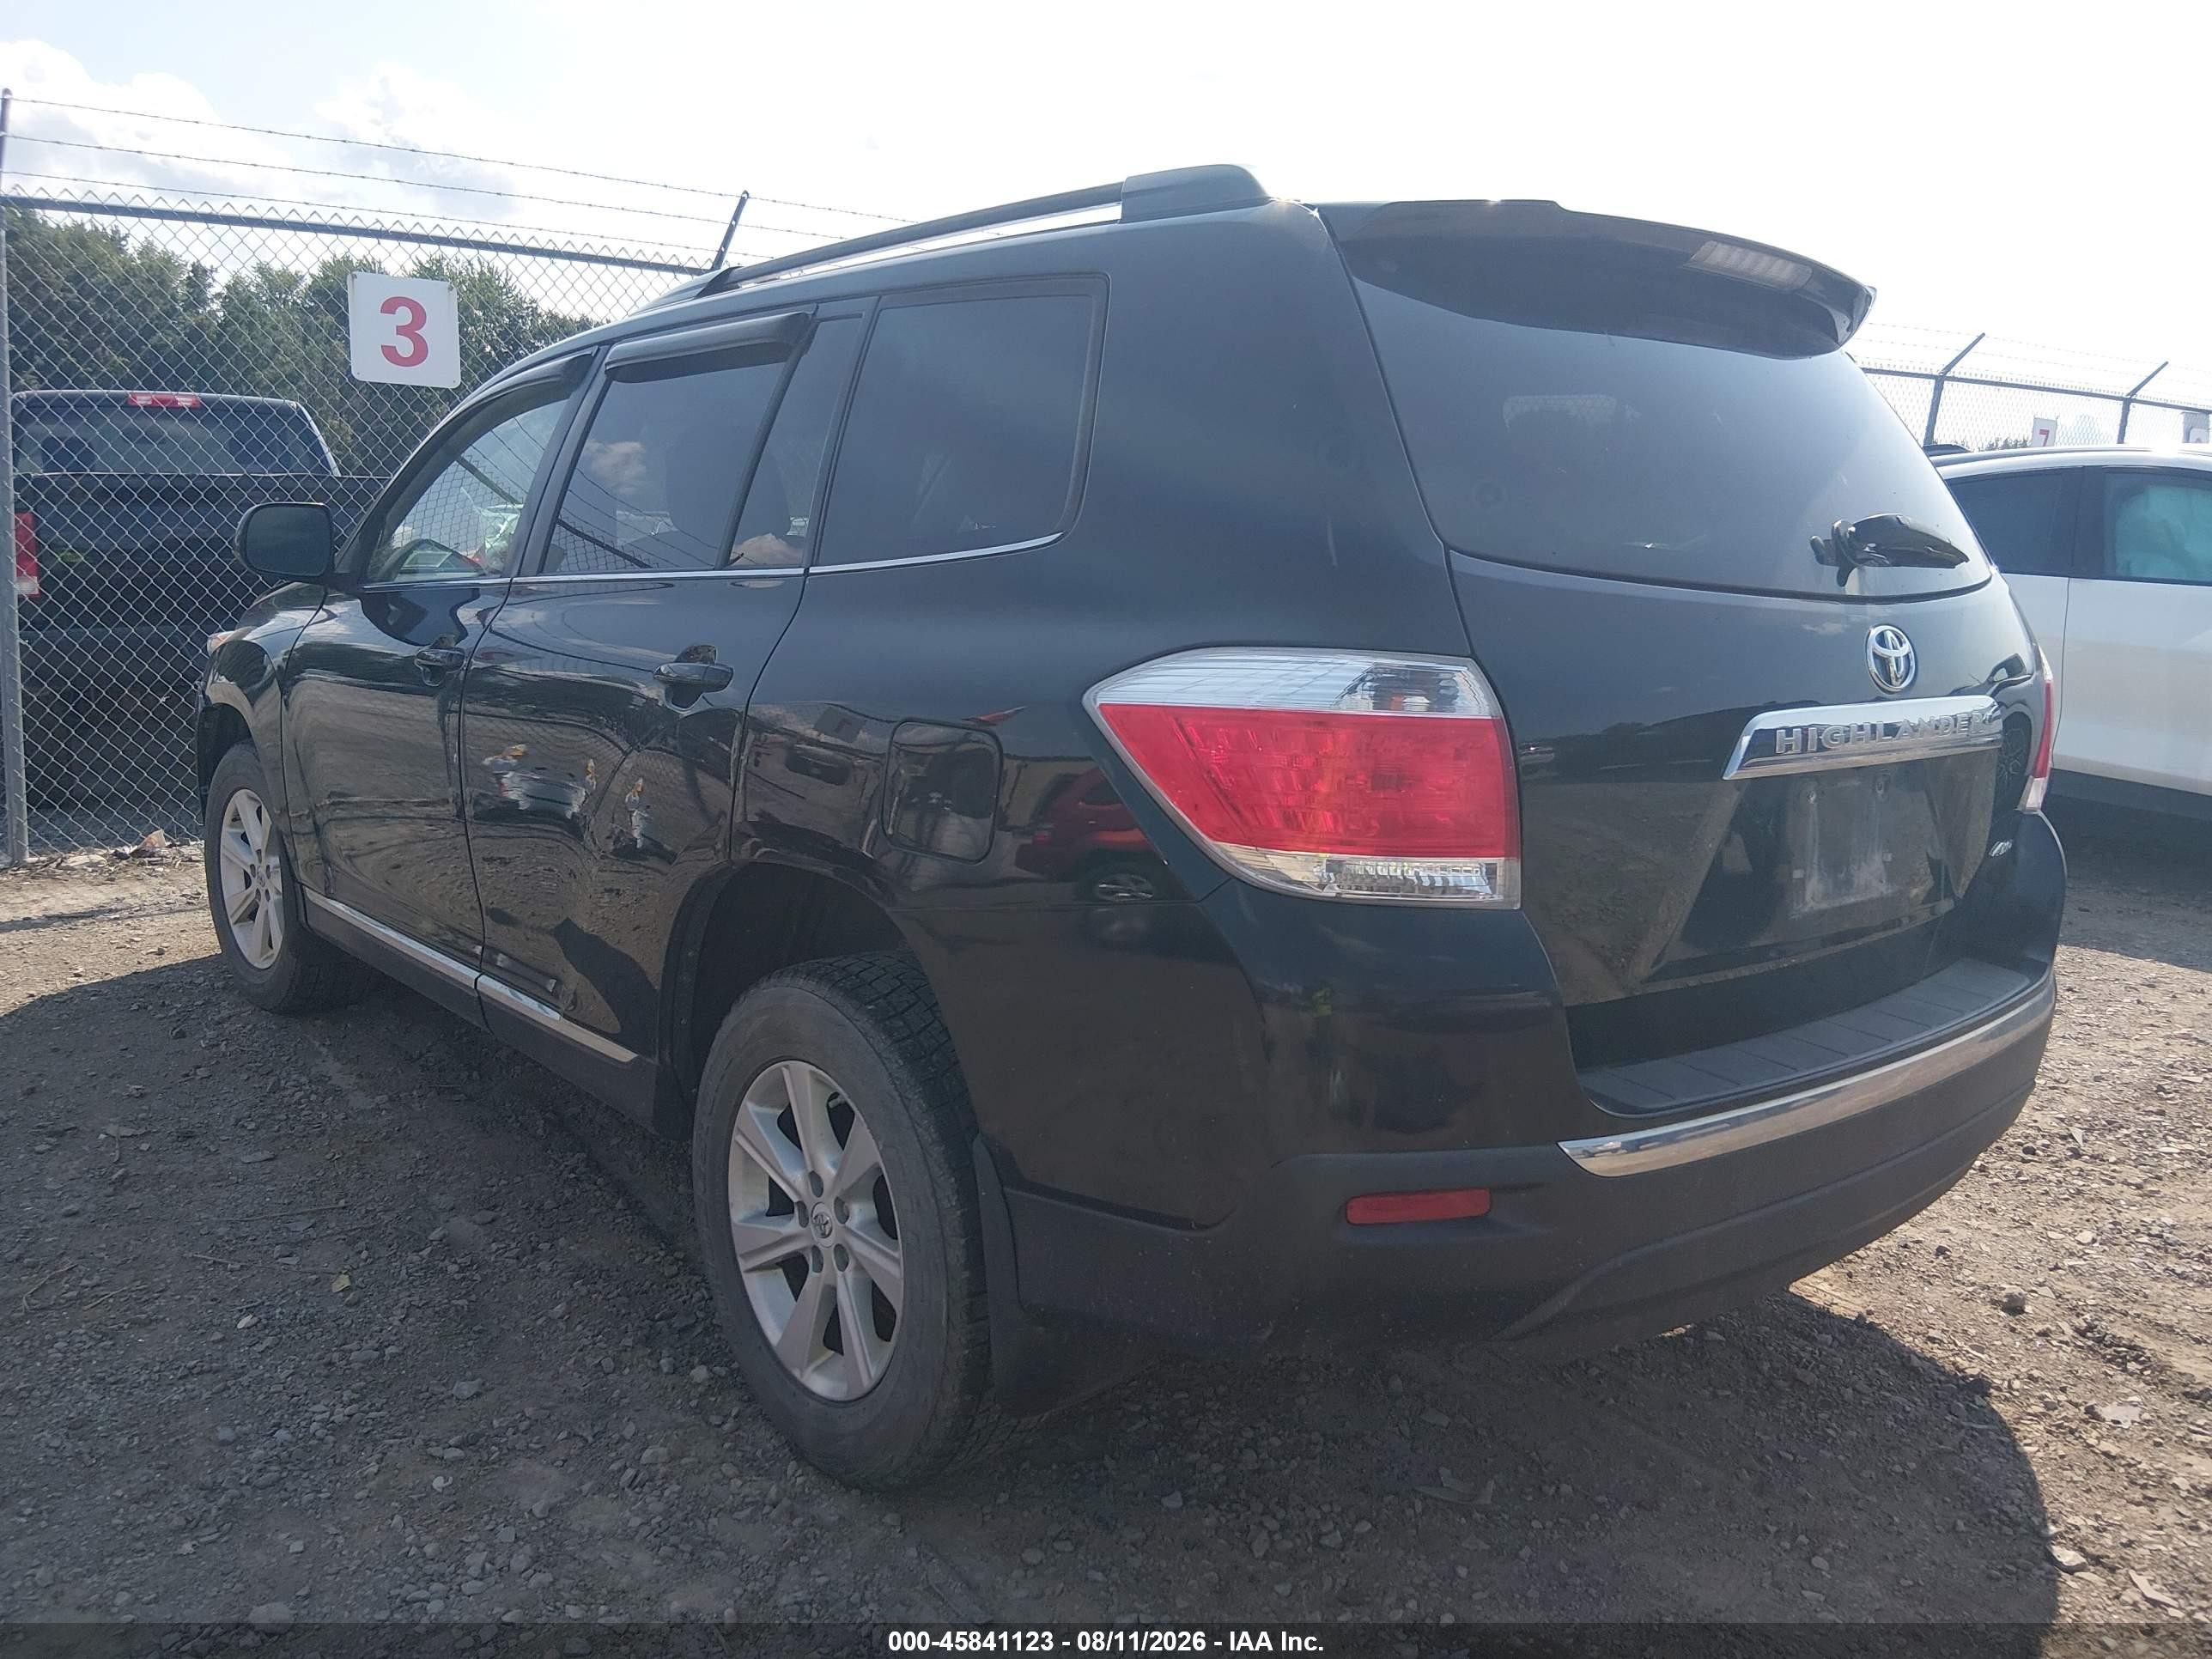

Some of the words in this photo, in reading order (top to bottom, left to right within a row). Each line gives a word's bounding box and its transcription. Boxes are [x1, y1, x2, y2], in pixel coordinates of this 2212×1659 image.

[380, 296, 428, 367] 3
[2039, 428, 2050, 447] 7
[1775, 711, 1987, 754] HIGHLANDER
